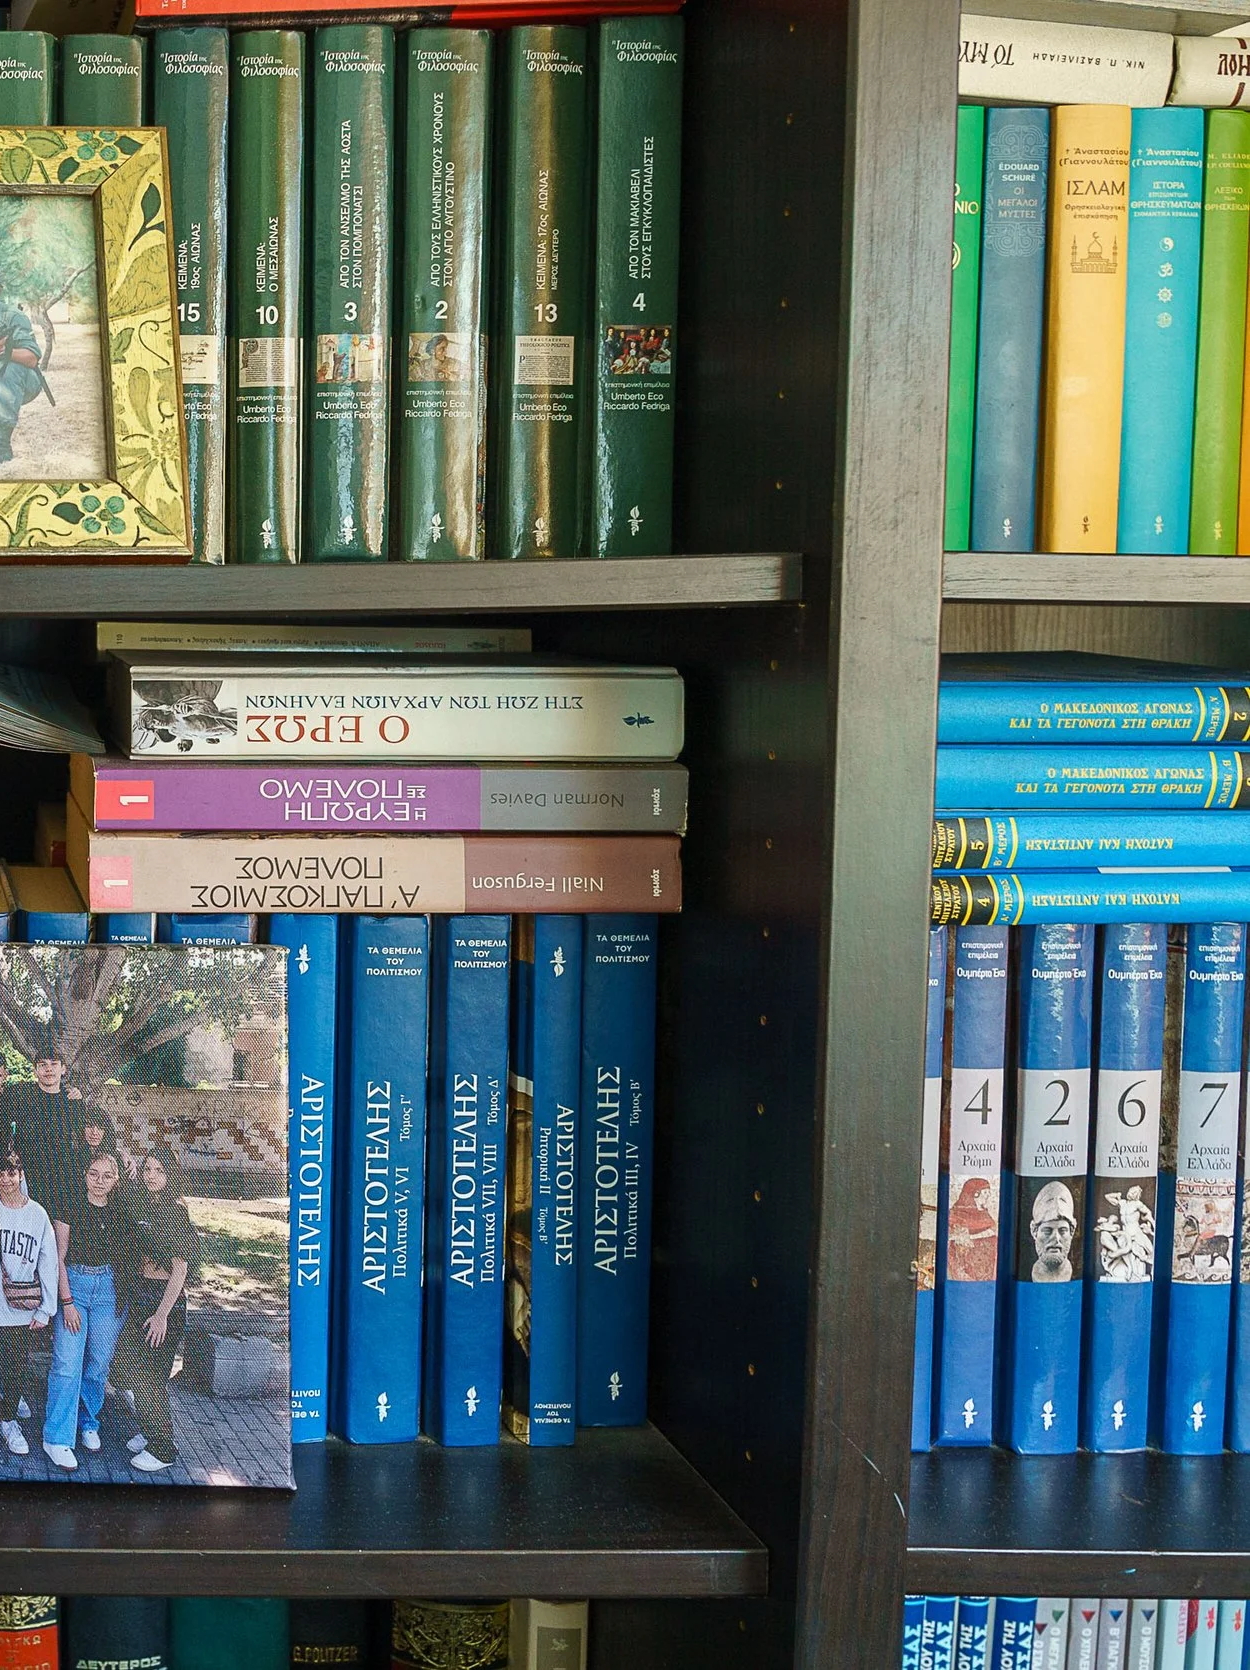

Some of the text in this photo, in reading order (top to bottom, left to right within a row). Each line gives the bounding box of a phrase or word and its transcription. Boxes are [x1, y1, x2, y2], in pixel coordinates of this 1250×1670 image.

[617, 51, 678, 63] Φιλοσοφίας
[1033, 52, 1101, 66] ΒΑΣΙΛΕΙΑΔΗ
[165, 63, 224, 75] Φιλοσοφίας
[430, 92, 444, 287] ΑΠΟ ΤΟΥΣ ΕΛΛΗΝΙΣΤΙΚΟΥΣ ΧΡΟΝΟΥΣ
[444, 162, 455, 226] ΑΥΓΟΥΣΤΙΝΟ
[630, 168, 641, 227] ΜΑΚΙΑΒΕΛΙ
[1067, 180, 1126, 196] ΙΣΛΑΜ
[339, 119, 352, 289] ΑΠΟ ΤΟΝ ΑΝΣΕΛΜΟ ΤΗΣ ΑΟΣΤΑ
[641, 136, 655, 279] ΣΤΟΥΣ ΕΓΚΥΚΛΟΠΑΙΔΙΣΤΕΣ
[352, 185, 363, 289] ΣΤΟΝ ΠΟΜΠΟΝΑΤΣΙ
[268, 217, 279, 280] ΜΕΣΑΙΩΝΑΣ
[256, 242, 266, 293] ΚΕΙΜΕΝΑ:
[443, 258, 453, 287] ΣΤΟΝ
[177, 302, 201, 323] 15
[344, 302, 358, 322] 3
[434, 300, 449, 320] 2
[533, 303, 558, 323] 13
[632, 292, 647, 312] 4
[255, 305, 279, 325] 10
[246, 695, 583, 709] ΣΤΗ ΖΩΗ ΤΩΝ ΑΡΧΑΙΩΝ ΕΛΛΗΝΩΝ
[1053, 703, 1193, 714] ΜΑΚΕΔΟΝΙΚΟΣ ΑΓΩΝΑΣ
[246, 715, 410, 744] Ο ΕΡΩΣ
[1009, 718, 1192, 729] ΚΑΙ ΤΑ ΓΕΓΟΝΟΤΑ ΣΤΗ ΘΡΑΚΗ
[259, 779, 402, 799] ΠΟΛΕΜΟ
[490, 793, 624, 807] Norman Davies
[284, 802, 409, 822] ΕΥΡΩΠΗ
[971, 839, 985, 851] 5
[1025, 838, 1174, 851] ΚΑΤΟΧΗ ΚΑΙ ΑΝΤΙΣΤΑΣΗ
[235, 857, 383, 880] ΠΟΛΕΜΟΣ
[472, 872, 603, 893] Niall Ferguson
[190, 885, 383, 908] ΠΑΓΚΟΣΜΙΟΣ
[977, 897, 990, 907] 4
[381, 947, 422, 955] ΘΕΜΕΛΙΑ
[366, 968, 422, 976] ΠΟΛΙΤΙΣΜΟΥ
[963, 1078, 993, 1126] 4
[1043, 1079, 1071, 1126] 2
[1117, 1079, 1147, 1128] 6
[1199, 1082, 1229, 1128] 7
[539, 1127, 552, 1184] Ρητορική
[957, 1140, 997, 1154] Αρχαία
[1036, 1141, 1074, 1155] Αρχαία
[593, 1066, 621, 1276] ΑΡΙΣΤΟΤΕΛΗΣ
[962, 1155, 993, 1169] Ρώμη
[1033, 1156, 1075, 1169] Ελλάδα
[296, 1074, 324, 1288] ΑΡΙΣΤΟΤΕΛΗΣ
[361, 1080, 391, 1295] ΑΡΙΣΤΟΤΕΛΗΣ
[449, 1073, 479, 1289] ΑΡΙΣΤΟΤΕΛΗΣ
[554, 1104, 574, 1267] ΑΡΙΣΤΟΤΕΛΗΣ
[623, 1192, 639, 1259] Πολιτικά
[392, 1211, 409, 1279] Πολιτικά
[480, 1215, 496, 1283] Πολιτικά
[1003, 1620, 1017, 1645] ΤΗΣ
